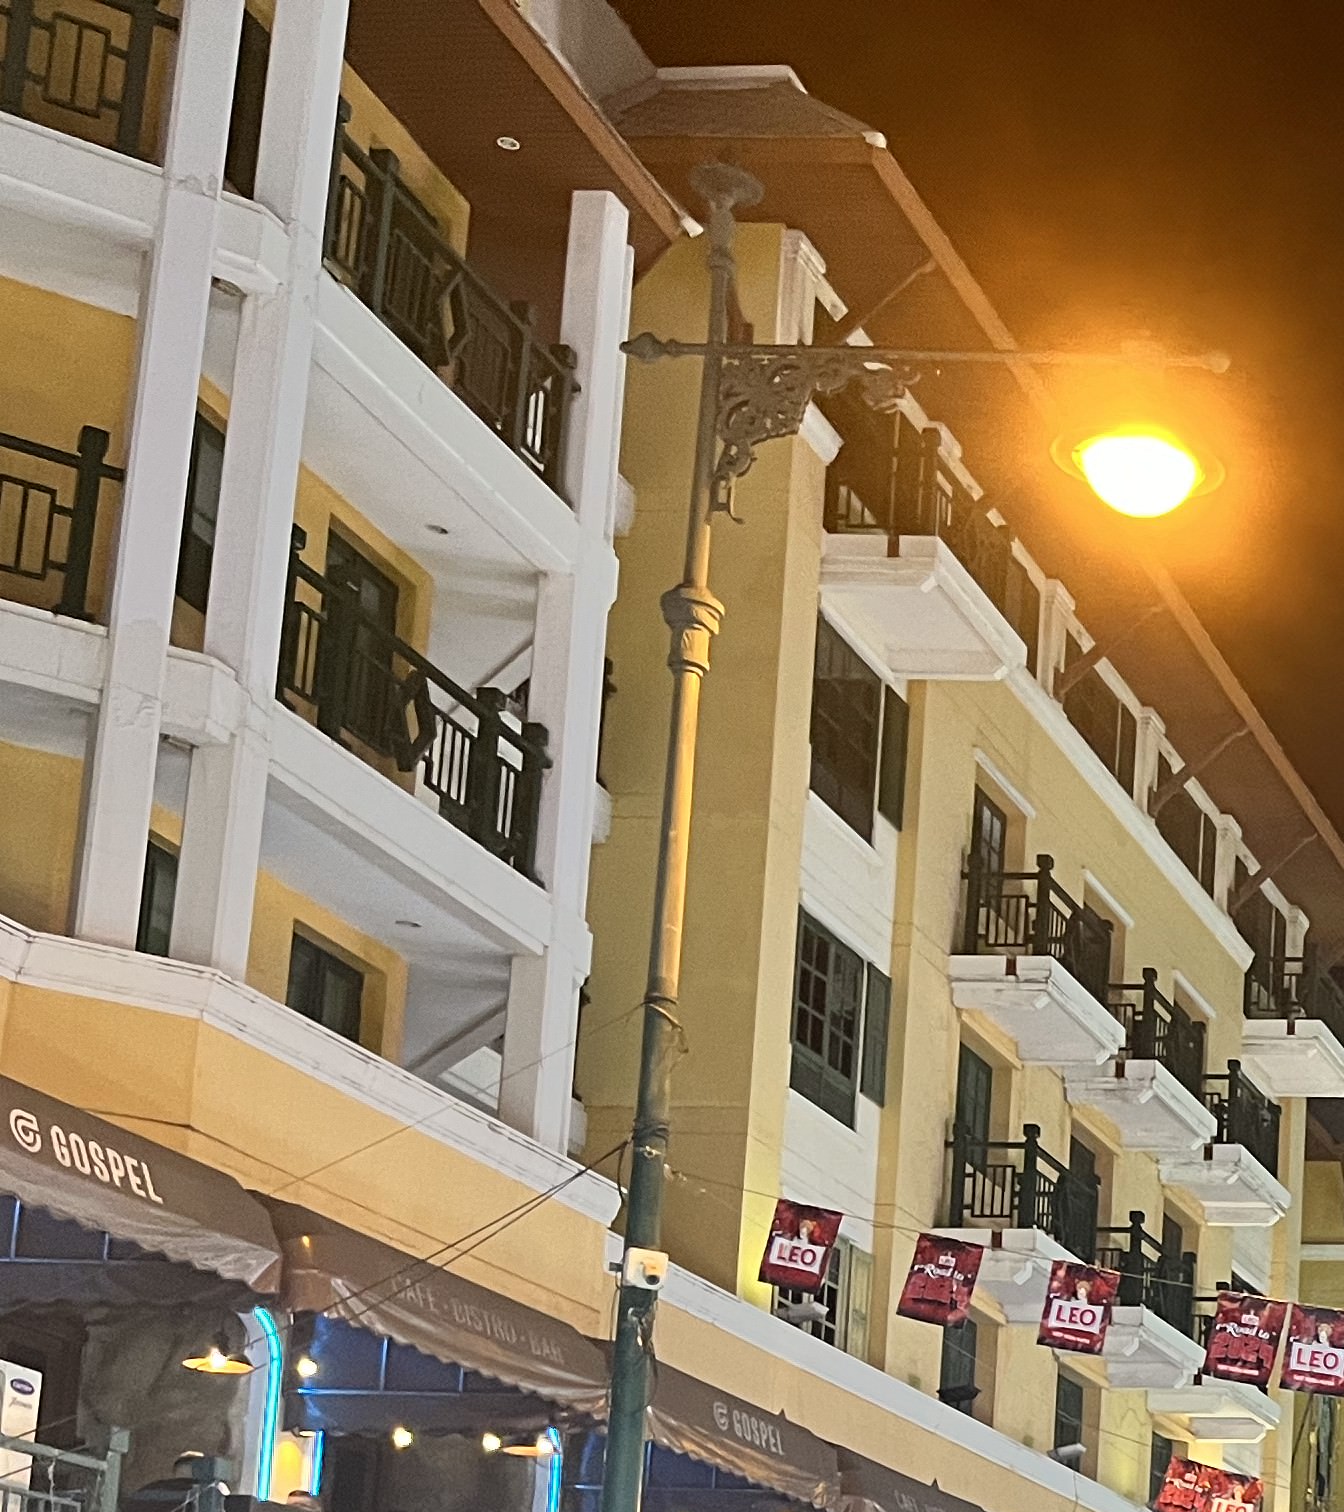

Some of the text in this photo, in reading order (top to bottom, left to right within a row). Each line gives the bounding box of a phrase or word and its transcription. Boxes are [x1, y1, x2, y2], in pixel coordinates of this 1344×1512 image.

[50, 1125, 164, 1204] GOSPEL
[776, 1242, 817, 1266] LEO
[922, 1262, 954, 1280] Road
[1055, 1305, 1098, 1327] LEO
[1221, 1322, 1259, 1338] Road
[1296, 1348, 1340, 1371] LEO
[732, 1410, 787, 1456] GOSPEL
